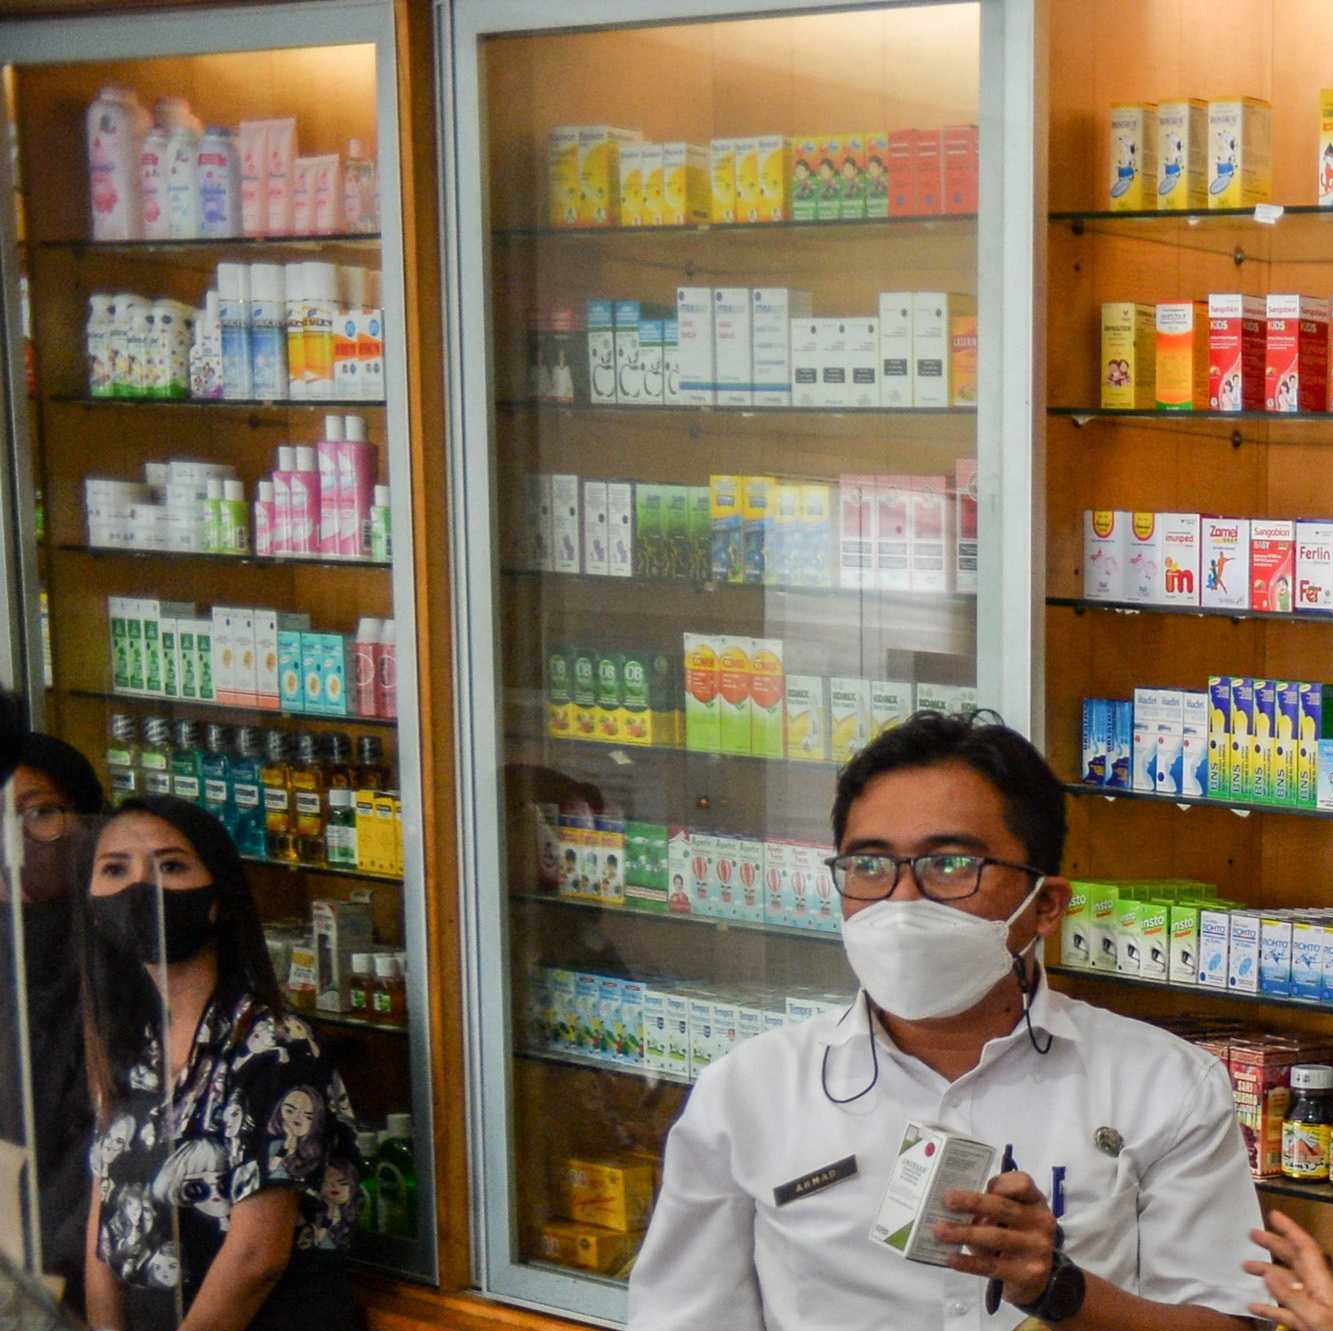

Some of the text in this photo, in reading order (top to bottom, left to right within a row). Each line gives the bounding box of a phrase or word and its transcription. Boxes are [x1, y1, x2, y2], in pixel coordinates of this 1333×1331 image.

[1253, 527, 1291, 538] Sangobion
[1300, 546, 1331, 560] Ferlin
[1300, 580, 1322, 604] Fer
